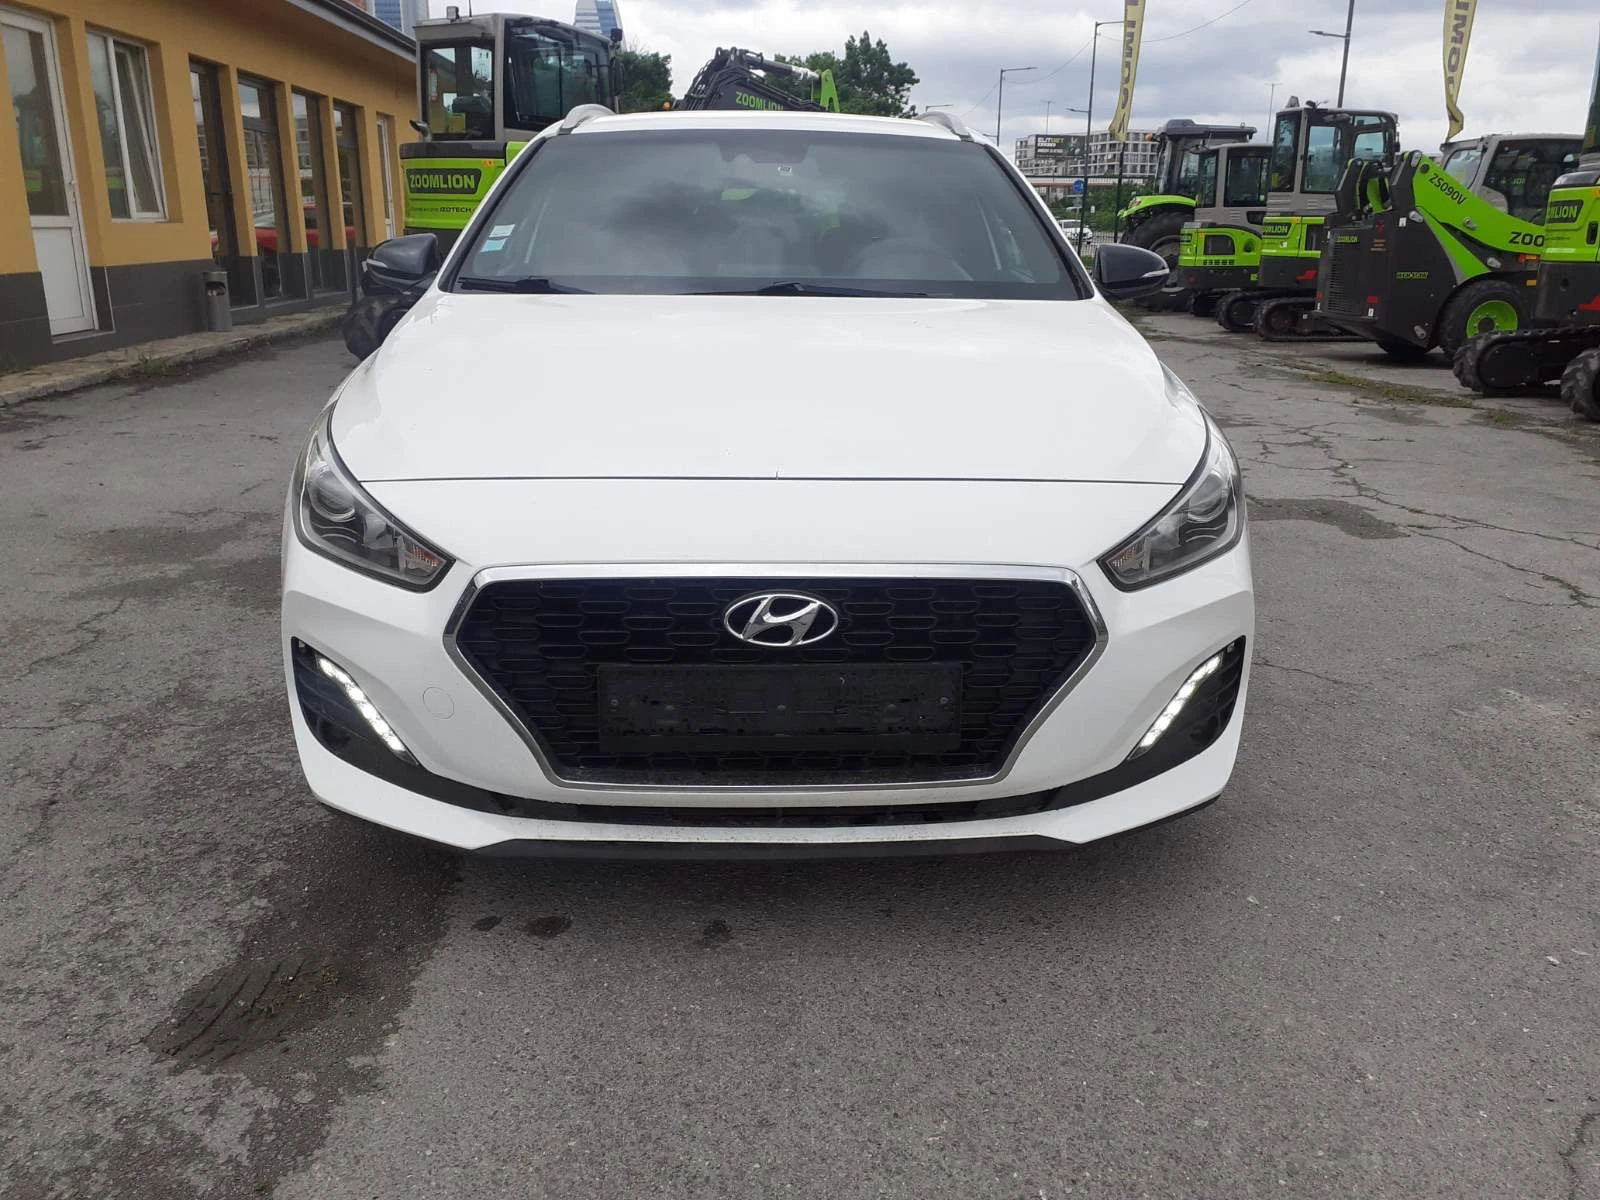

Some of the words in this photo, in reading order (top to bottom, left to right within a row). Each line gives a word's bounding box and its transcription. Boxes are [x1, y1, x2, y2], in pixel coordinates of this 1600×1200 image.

[409, 174, 476, 189] ZOOMLION
[1428, 173, 1467, 205] ZS090V
[1508, 231, 1545, 247] ZOO
